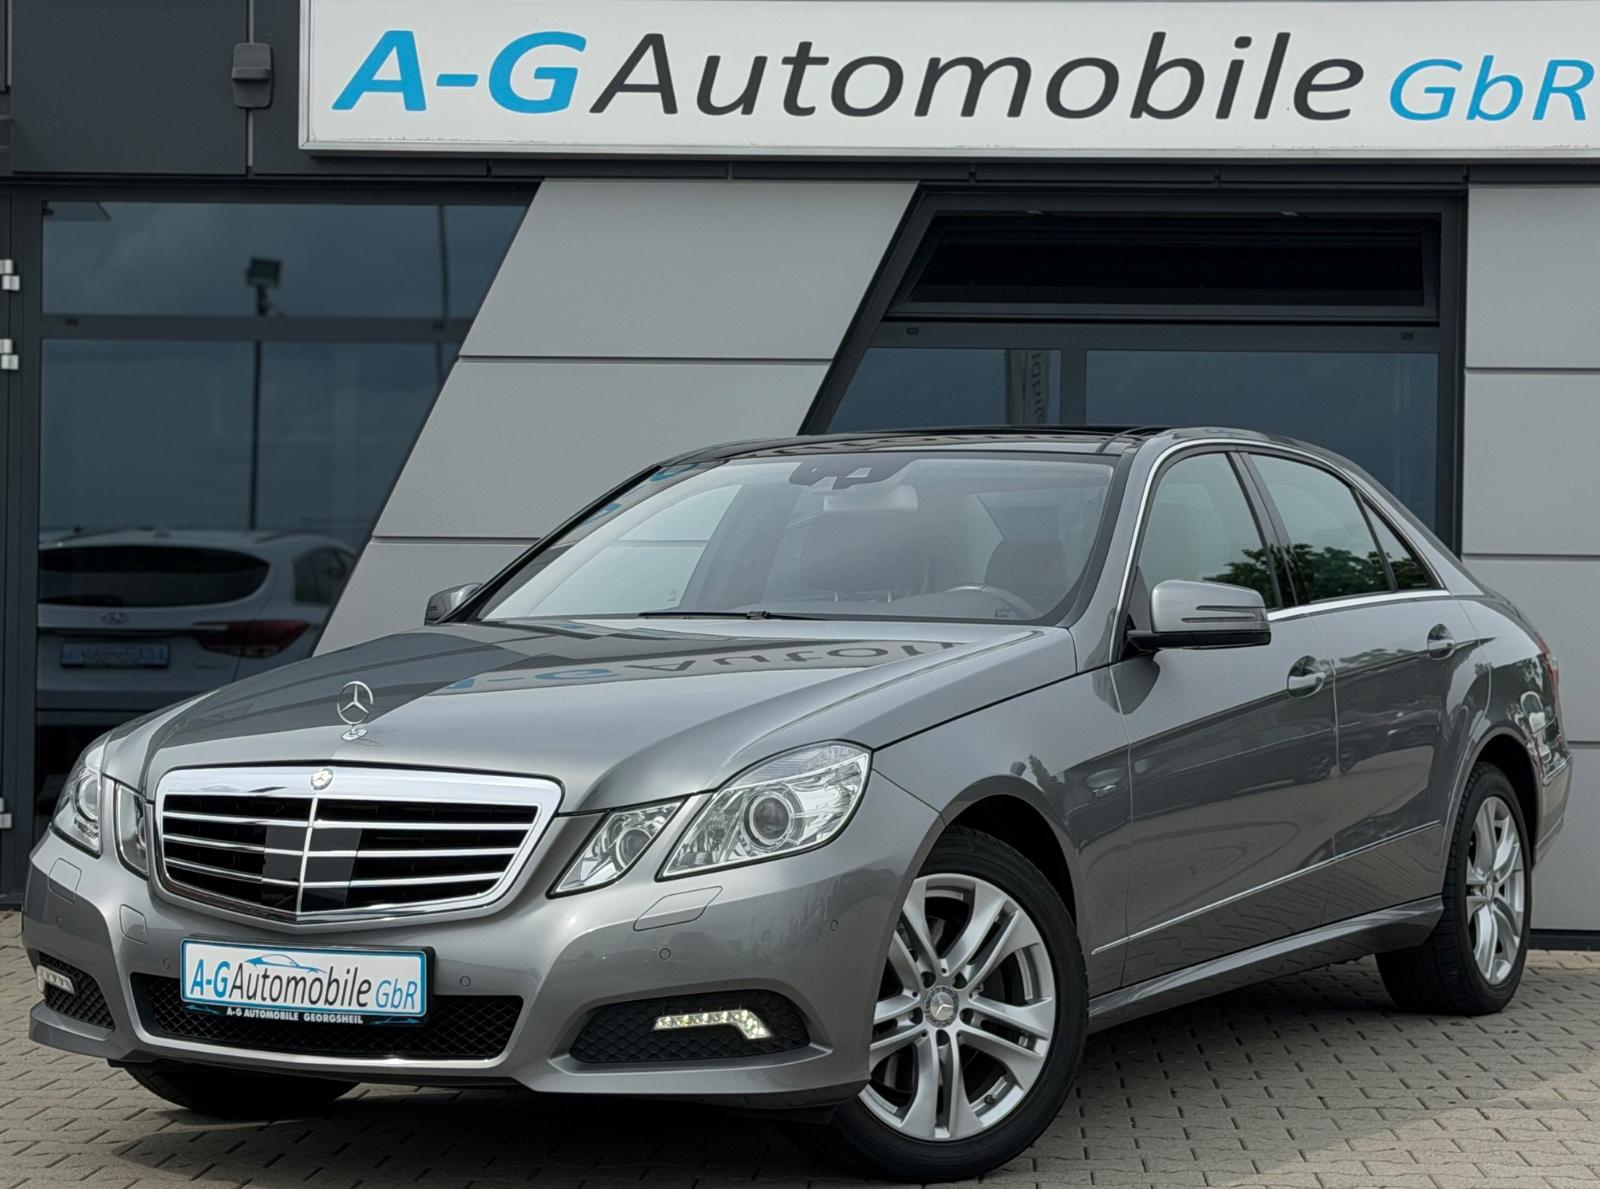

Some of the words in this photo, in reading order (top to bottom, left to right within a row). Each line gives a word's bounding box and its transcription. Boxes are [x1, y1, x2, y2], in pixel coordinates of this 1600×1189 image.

[332, 30, 587, 113] A-G
[589, 32, 1364, 120] Automobile
[1389, 54, 1594, 121] GbR
[190, 958, 230, 998] A-G
[229, 962, 372, 1008] Automobile
[374, 978, 419, 1011] GbR
[226, 1007, 243, 1017] A-G
[243, 1008, 299, 1021] AUTOMOBILE
[303, 1012, 363, 1024] GEORGSHEIL
